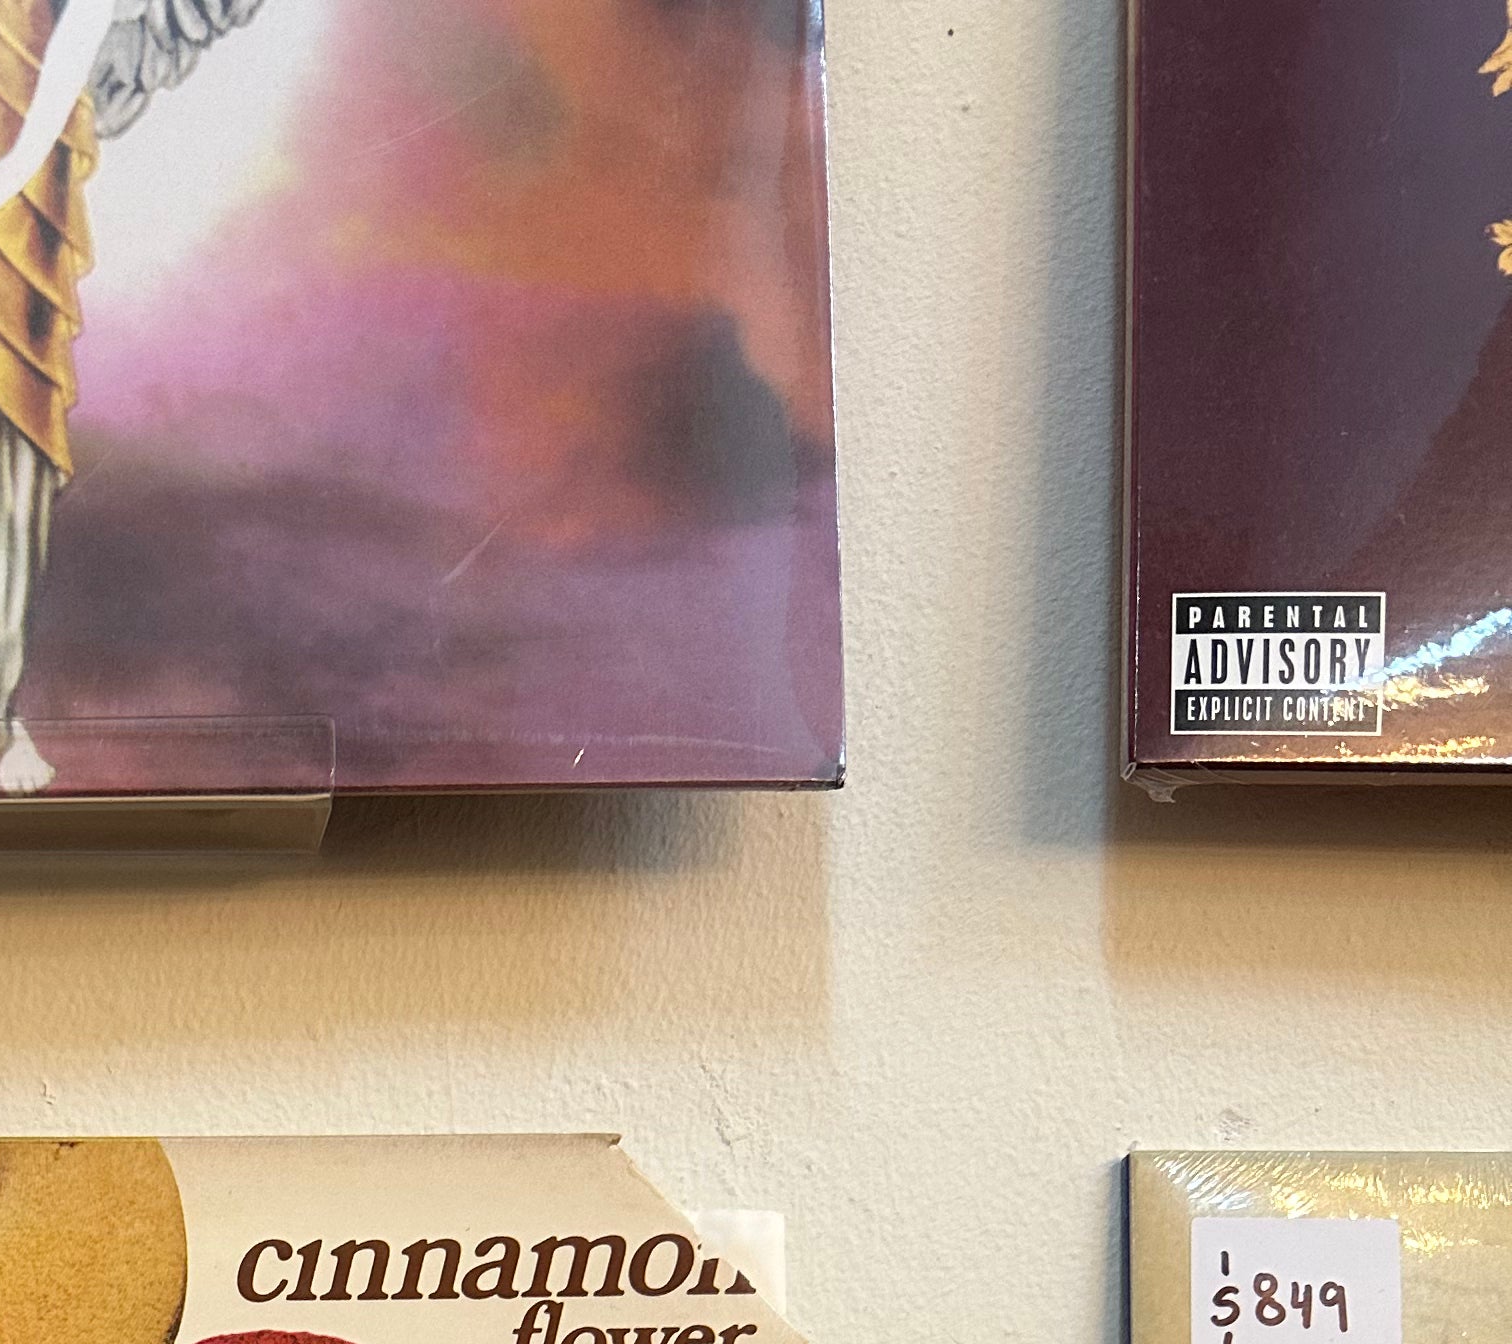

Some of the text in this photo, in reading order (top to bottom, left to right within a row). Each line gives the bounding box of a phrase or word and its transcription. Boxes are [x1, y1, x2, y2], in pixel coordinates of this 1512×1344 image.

[1188, 605, 1370, 629] PARENTAL
[1183, 638, 1371, 686] ADVISORY
[1187, 696, 1273, 722] EXPLICIT
